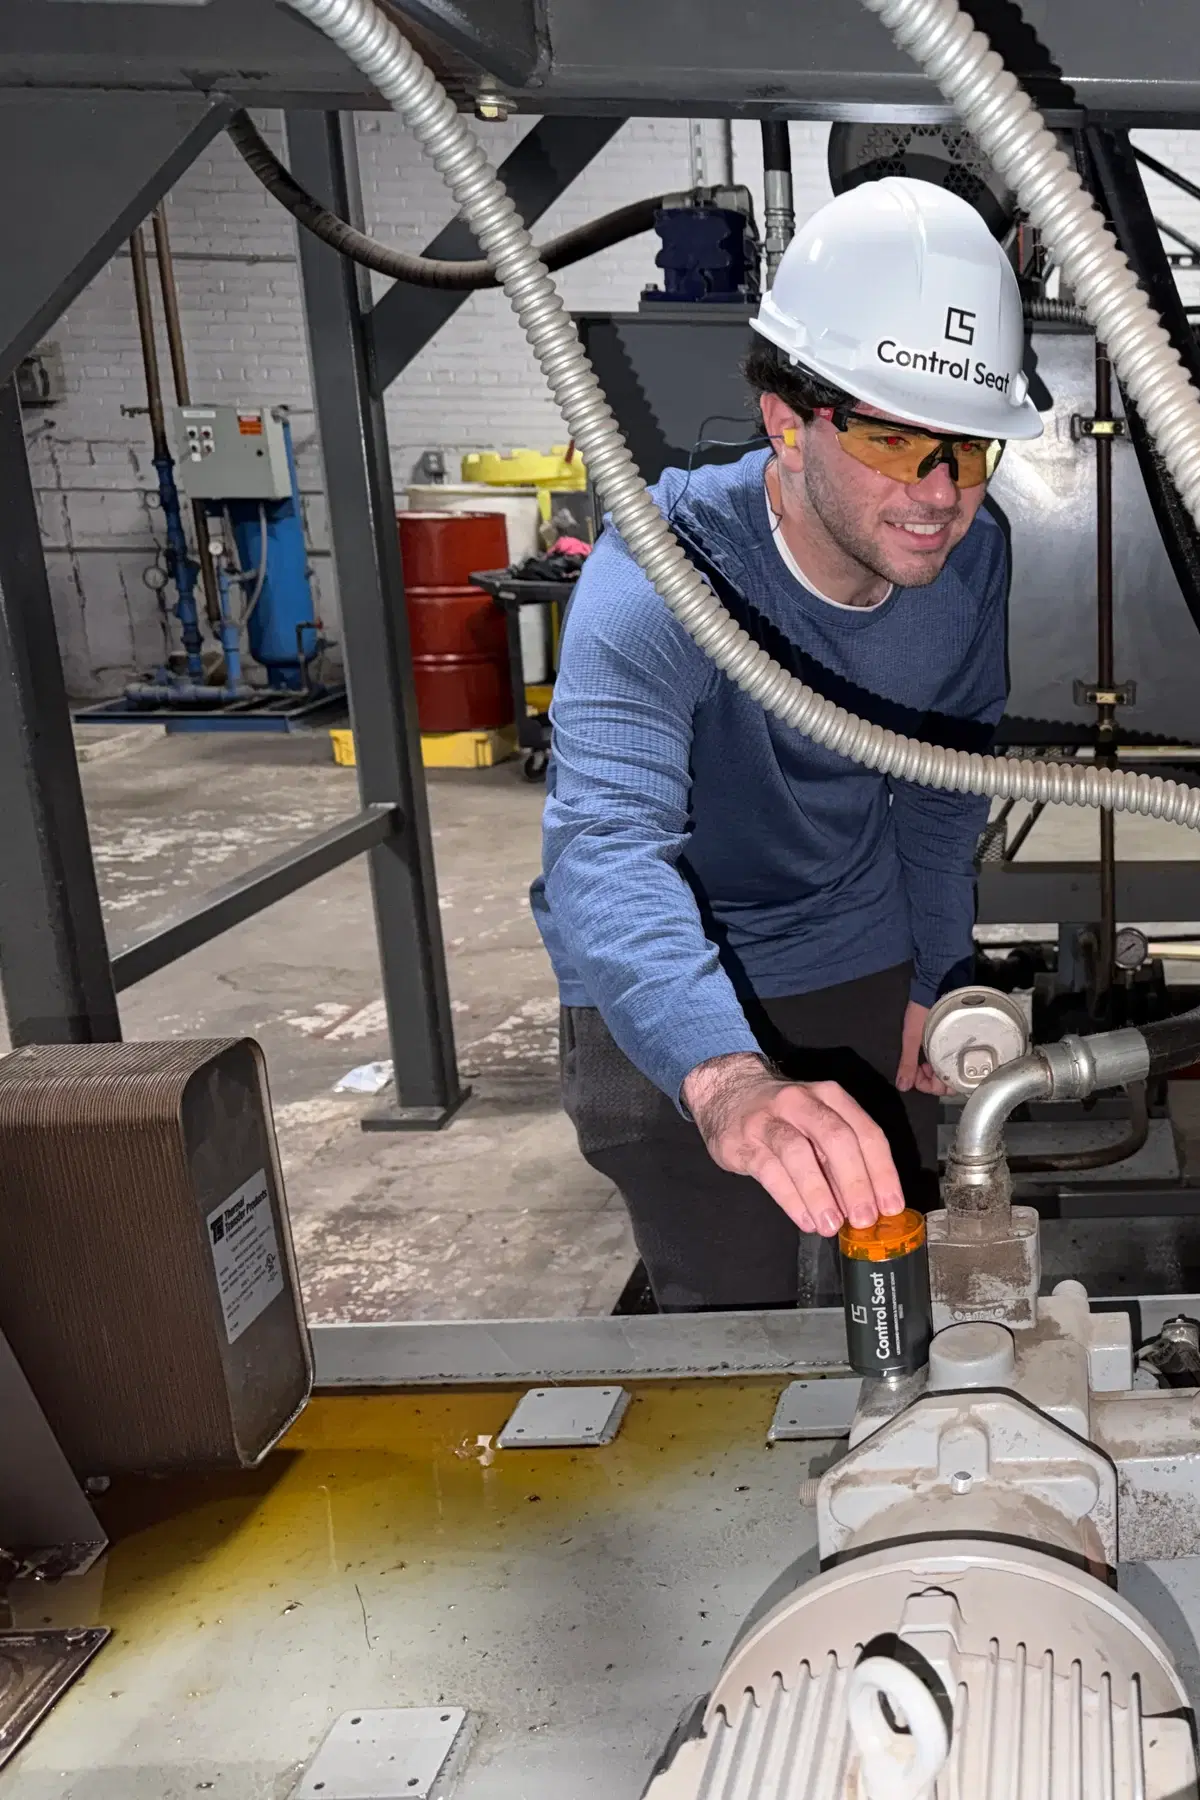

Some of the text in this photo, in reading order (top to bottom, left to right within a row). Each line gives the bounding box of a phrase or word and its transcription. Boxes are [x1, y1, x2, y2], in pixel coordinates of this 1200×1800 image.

[877, 340, 1010, 394] Control Seat
[870, 1272, 890, 1360] Control Seat
